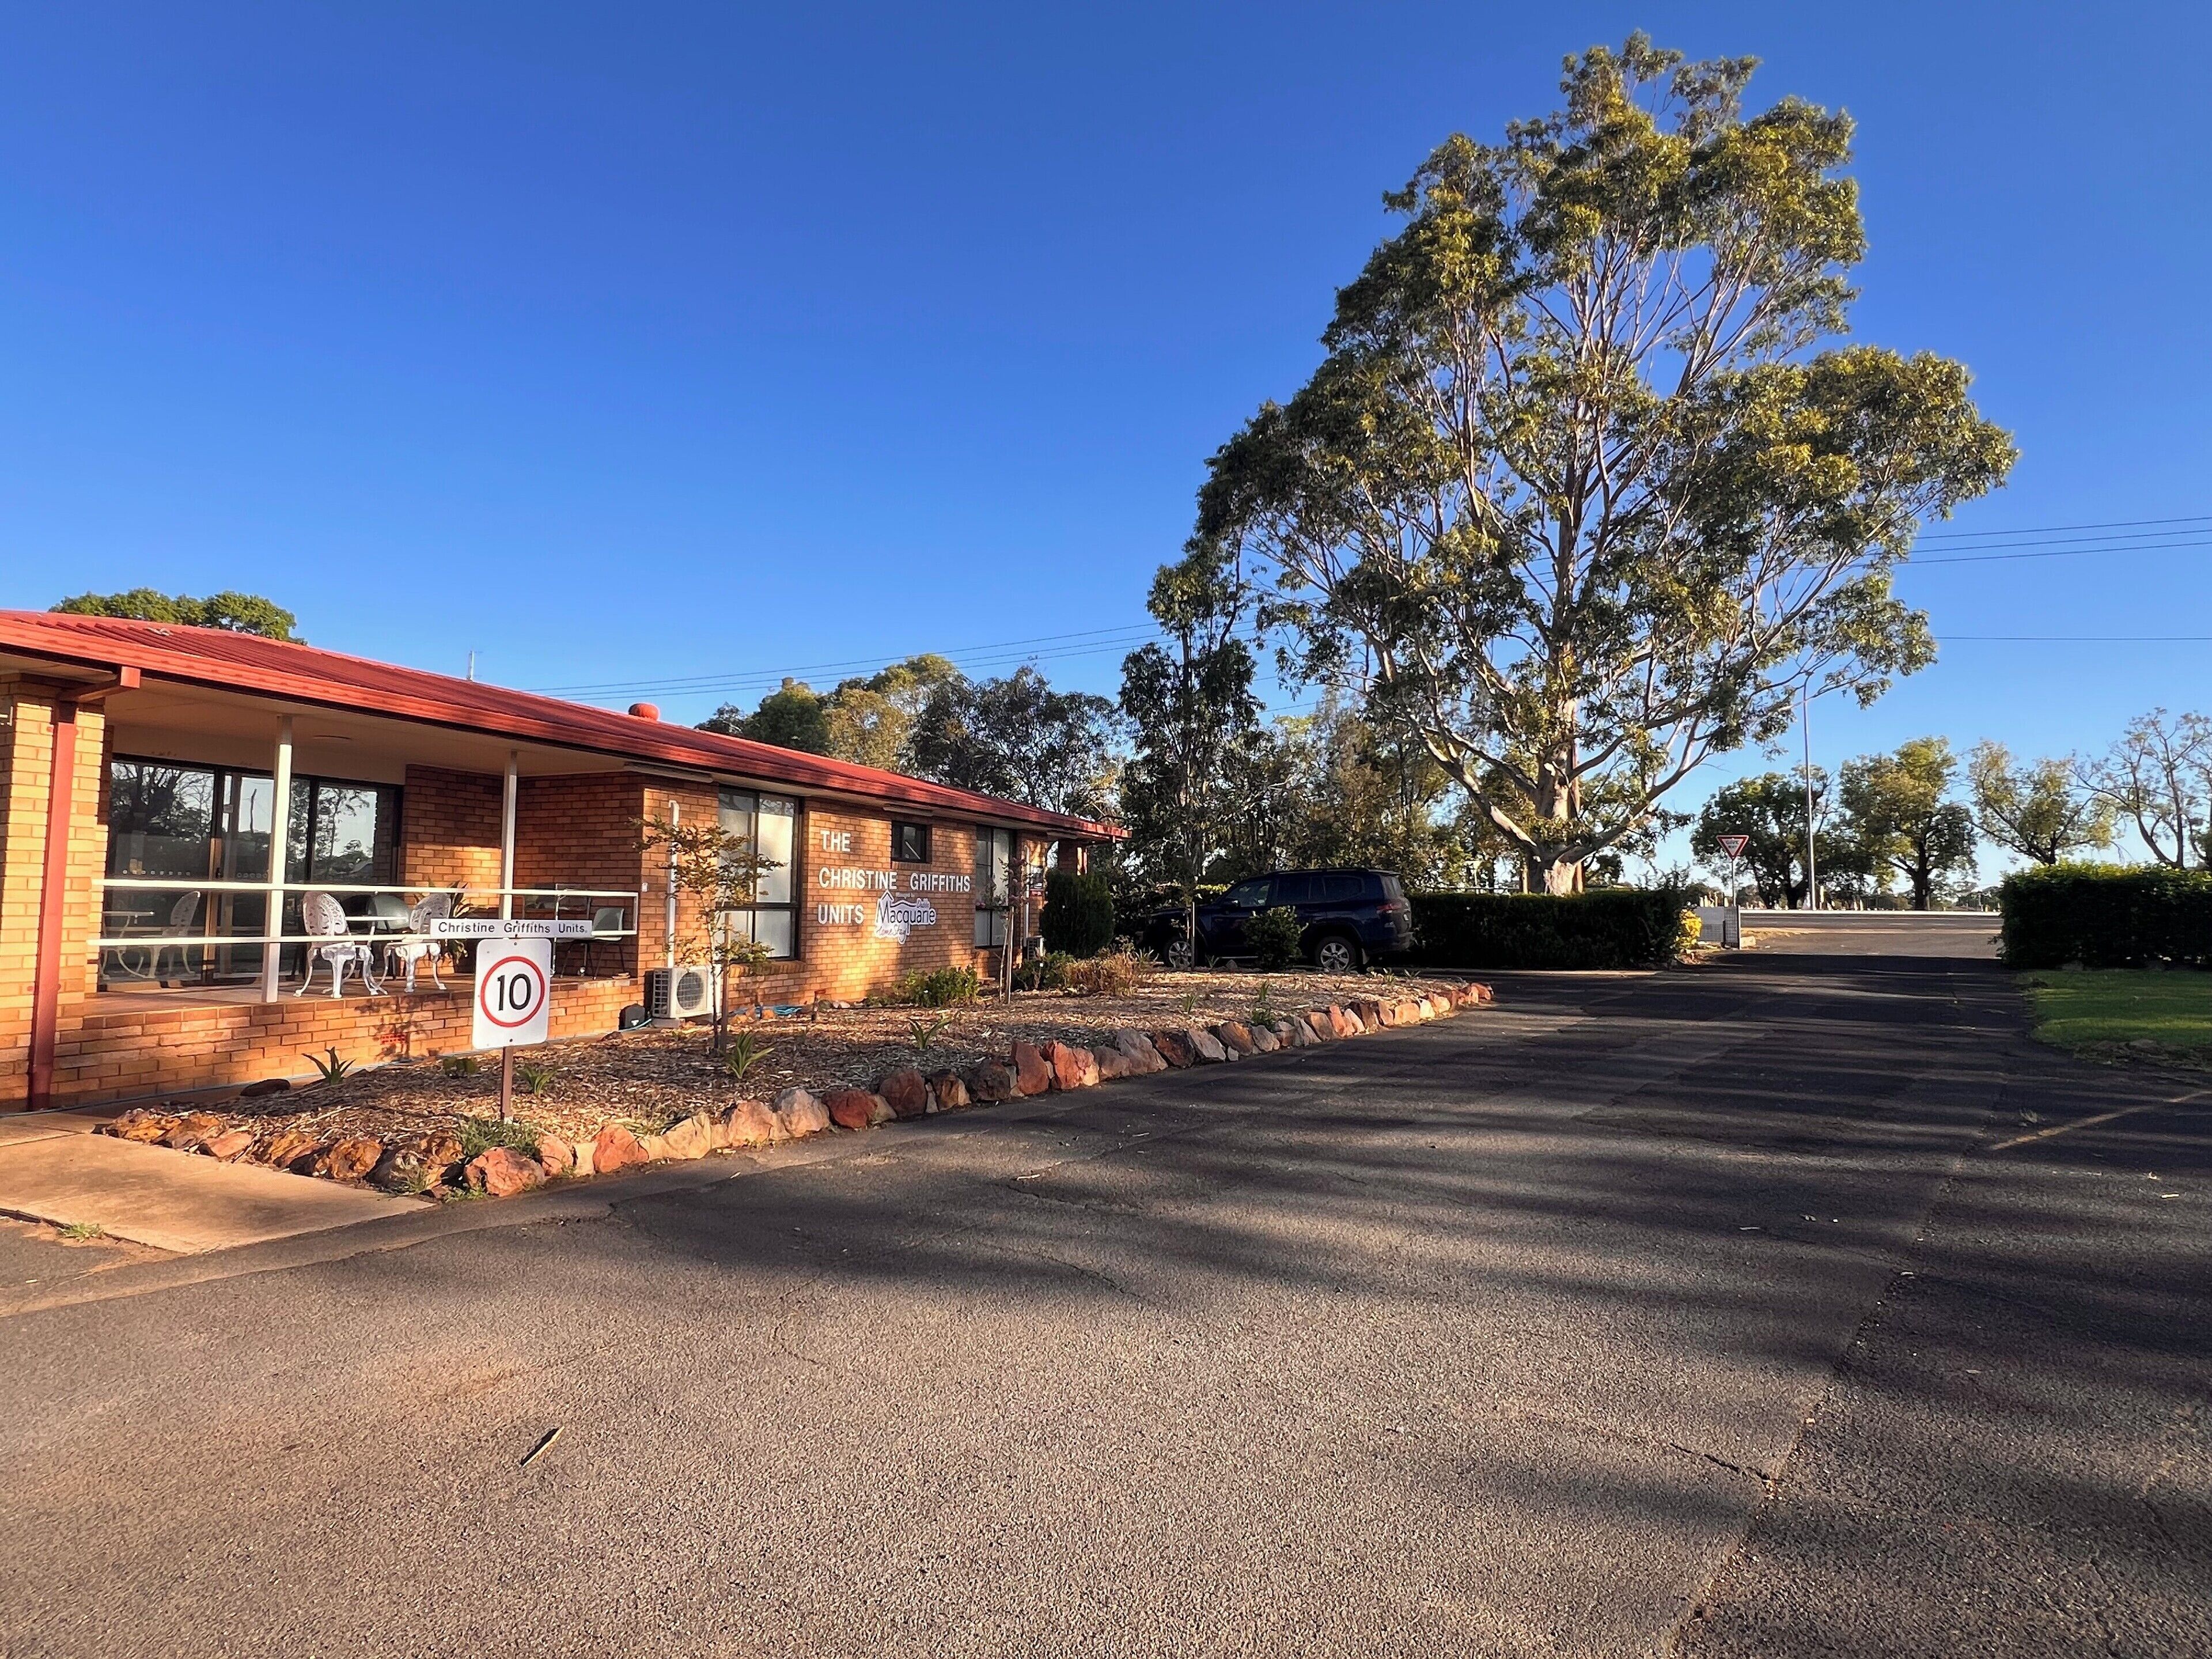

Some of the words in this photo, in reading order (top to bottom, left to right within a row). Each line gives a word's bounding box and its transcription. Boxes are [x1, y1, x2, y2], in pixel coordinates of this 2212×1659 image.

[820, 830, 851, 852] THE
[819, 866, 897, 889] CHRISTINE
[910, 873, 971, 892] GRIFFITHS
[818, 904, 864, 925] UNITS
[438, 922, 495, 933] Christine
[504, 923, 551, 934] Griffiths
[558, 923, 588, 933] Units.
[497, 974, 531, 1011] 10
